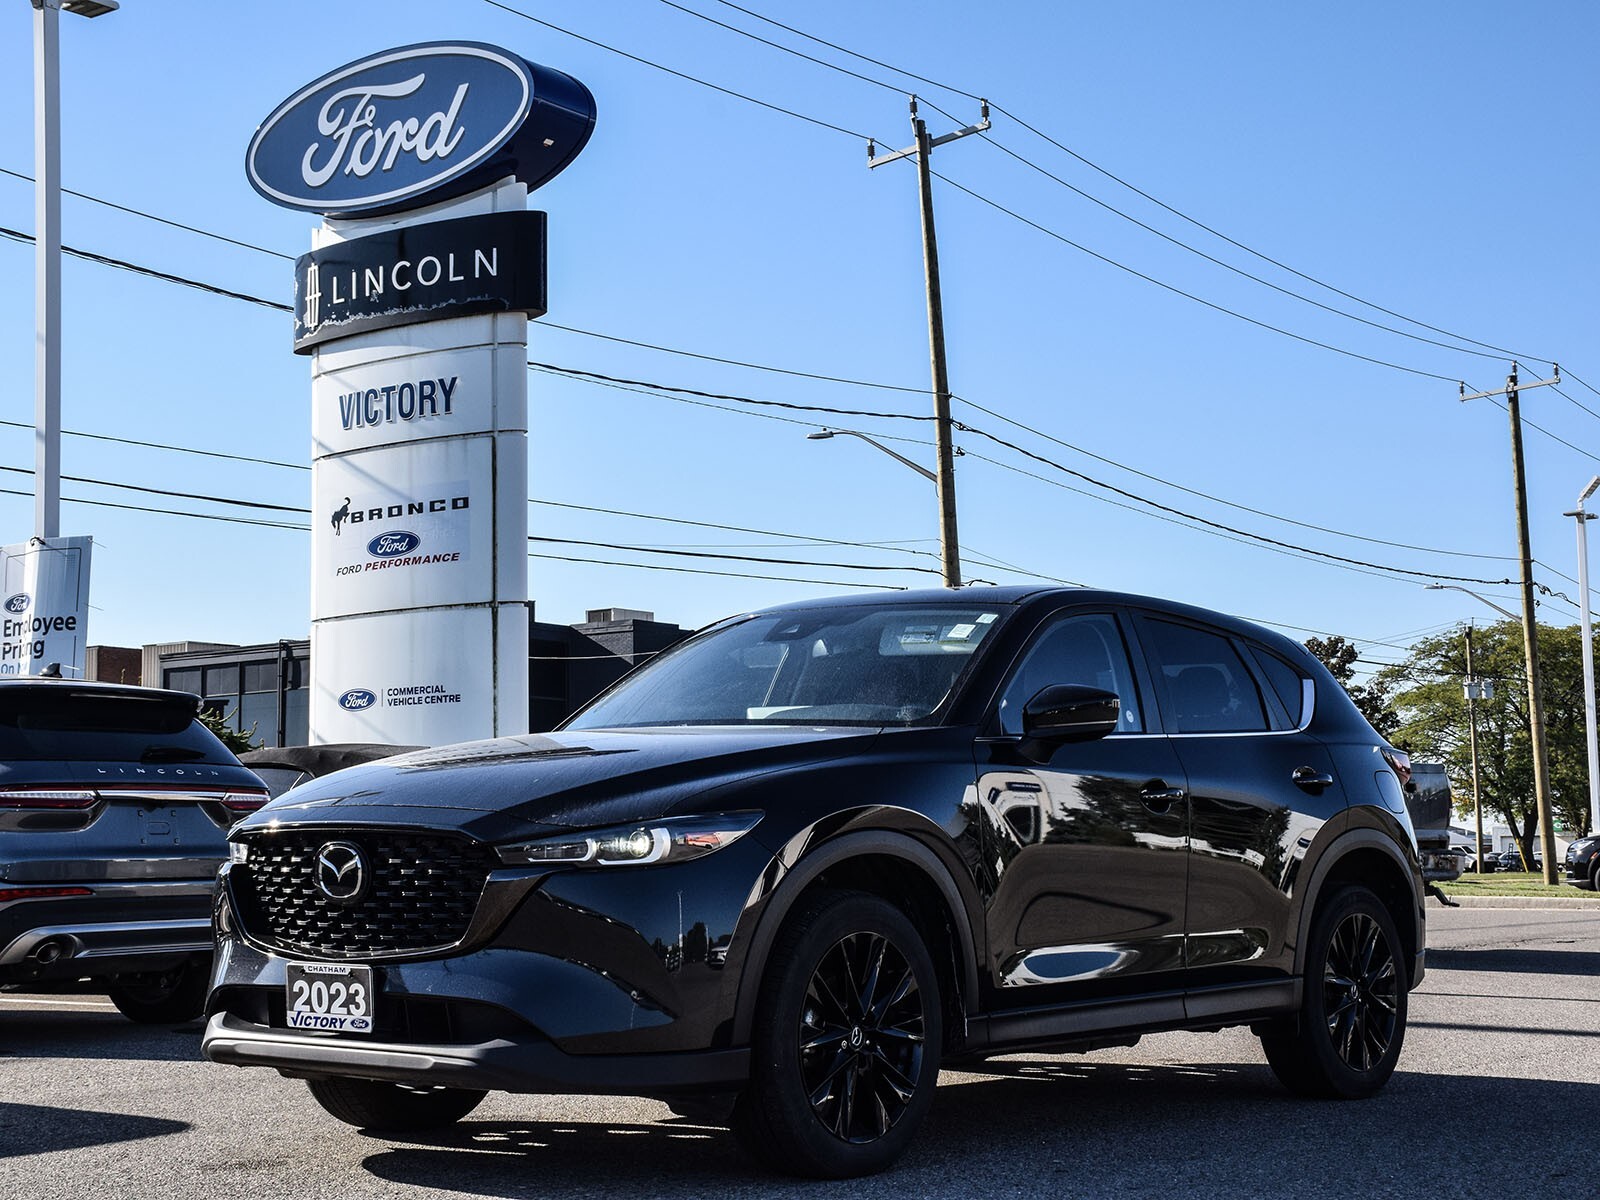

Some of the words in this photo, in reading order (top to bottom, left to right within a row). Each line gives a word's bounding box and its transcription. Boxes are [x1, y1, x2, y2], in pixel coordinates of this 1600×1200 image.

[302, 73, 469, 187] Ford
[333, 248, 497, 304] LINCOLN
[339, 377, 458, 431] VICTORY
[351, 497, 469, 524] BRONCO
[377, 535, 409, 554] Ford
[336, 564, 362, 576] FORD
[365, 552, 460, 571] PERFORMANCE
[2, 639, 45, 660] Pring
[345, 692, 369, 708] Ford
[387, 685, 446, 697] COMMERCIAL
[387, 697, 423, 707] VEHICLE
[424, 694, 461, 705] CENTRE
[308, 965, 346, 973] CHATHAM
[292, 979, 366, 1016] 2023
[291, 1011, 348, 1029] VICTORY
